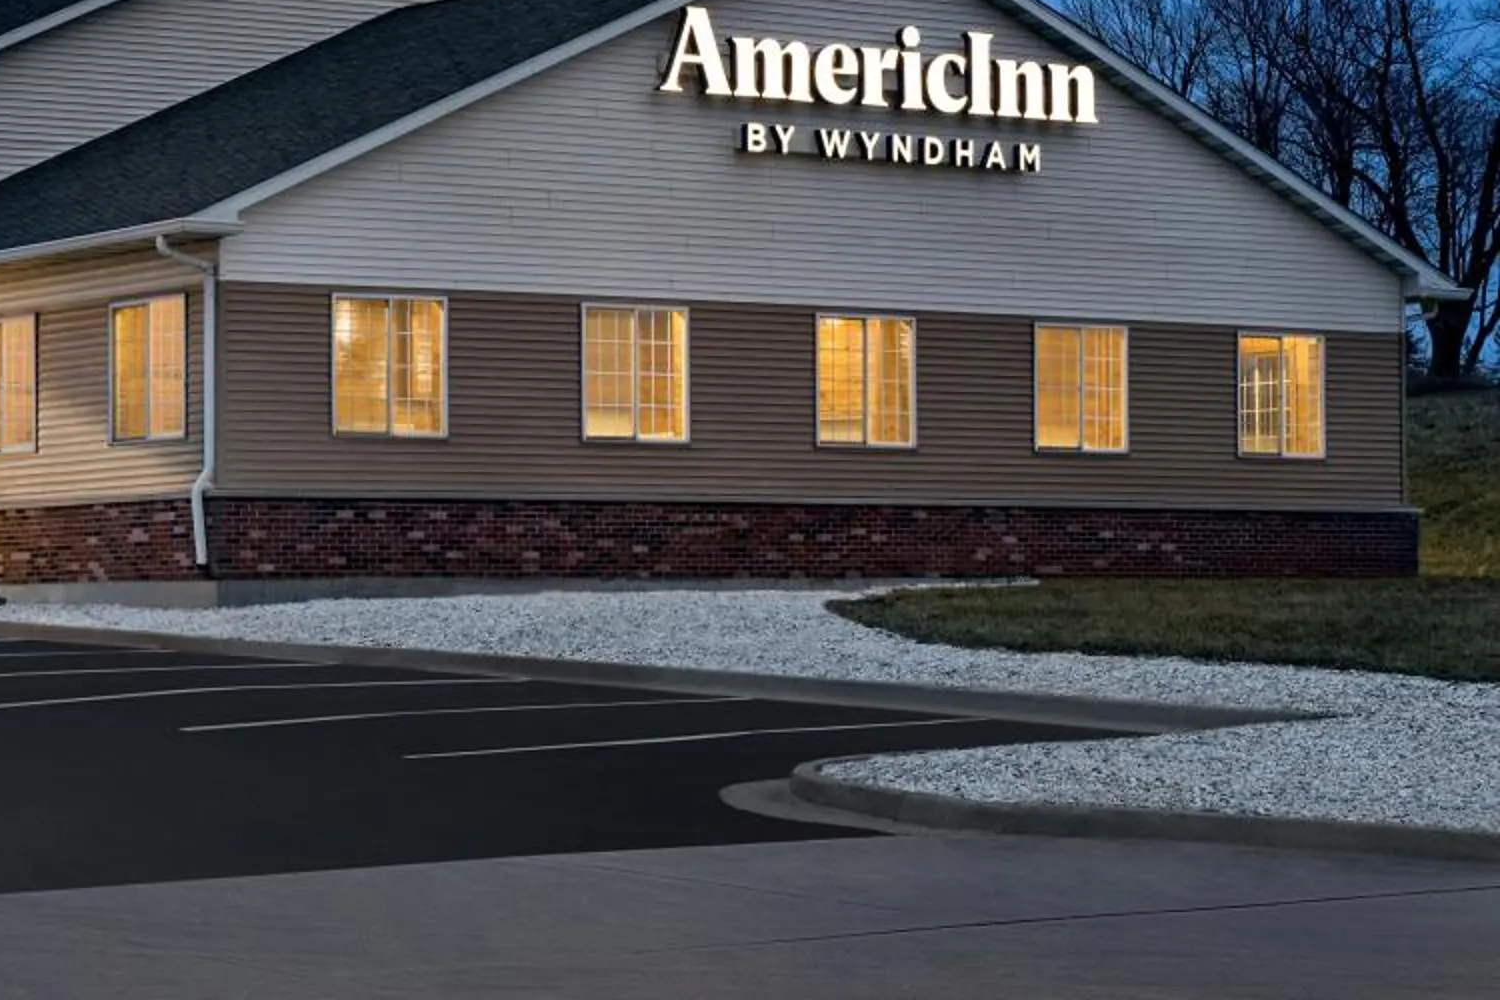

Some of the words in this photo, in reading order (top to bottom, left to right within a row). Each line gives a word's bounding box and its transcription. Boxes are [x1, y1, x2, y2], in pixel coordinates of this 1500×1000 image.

[659, 6, 1099, 124] AmericInn
[746, 122, 795, 154] BY
[819, 128, 1042, 173] WYNDHAM
